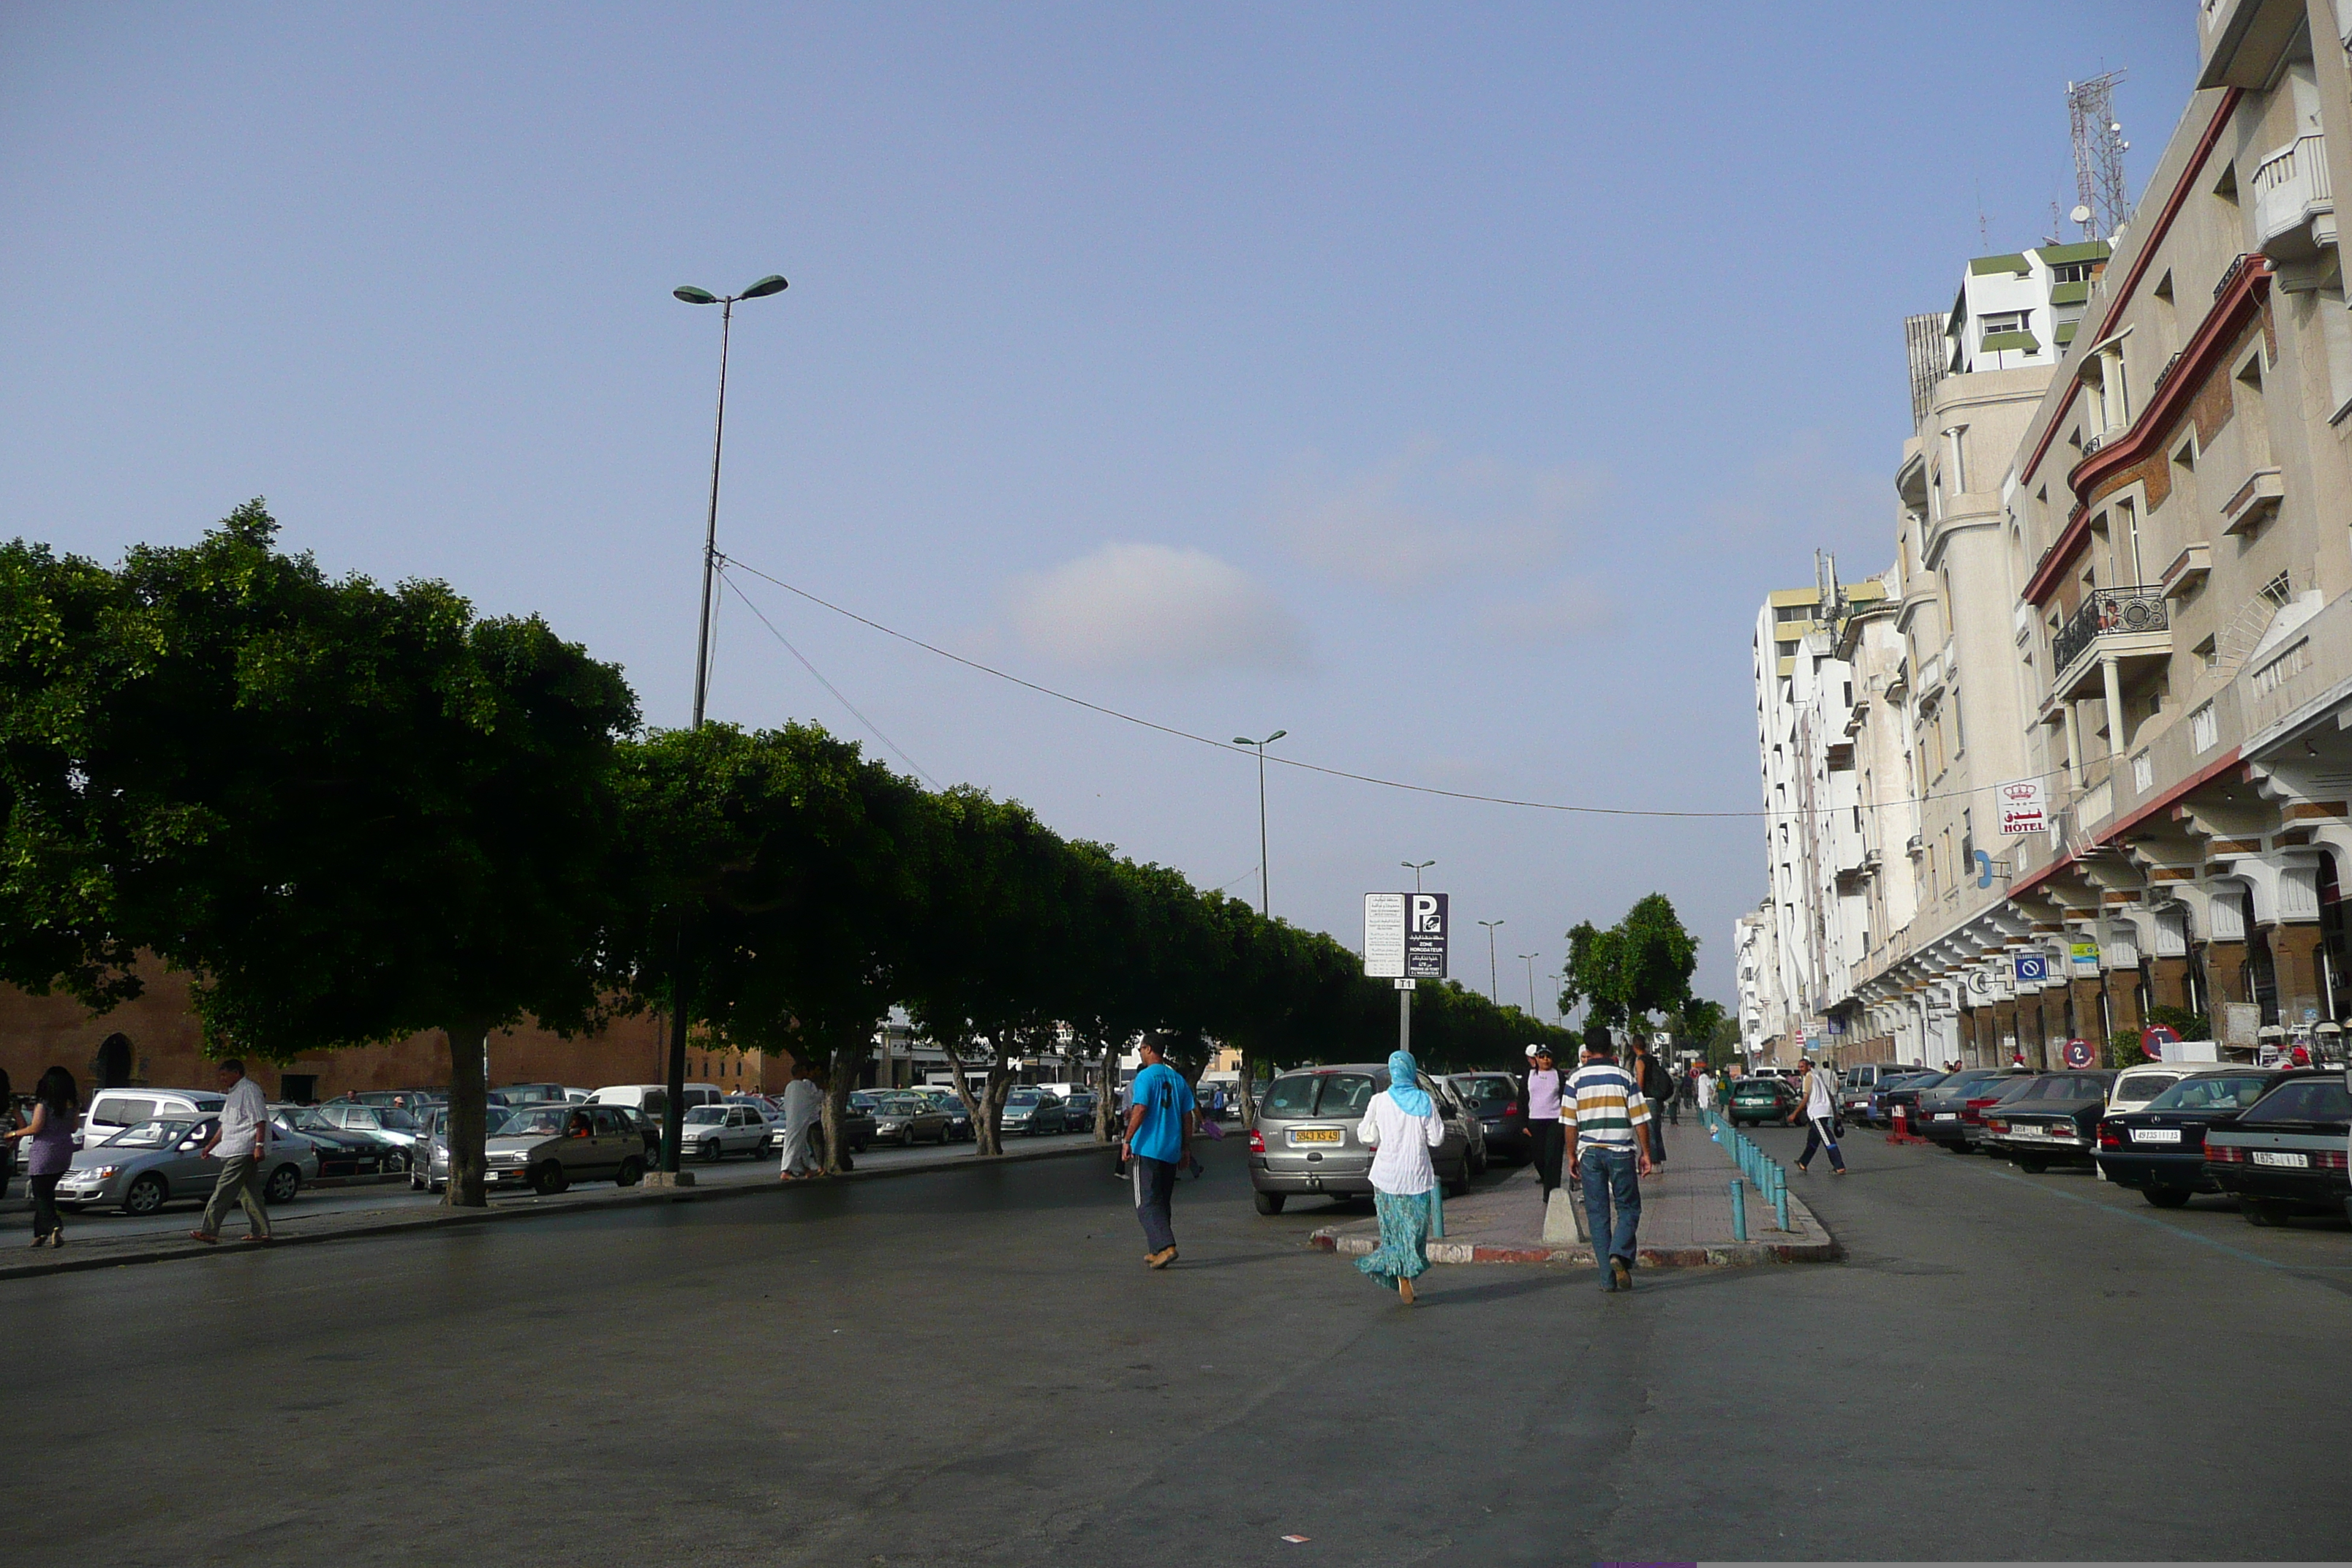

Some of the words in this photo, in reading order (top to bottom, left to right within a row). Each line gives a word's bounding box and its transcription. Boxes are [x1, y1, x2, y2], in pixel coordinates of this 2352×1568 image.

[2005, 808, 2043, 823] فندق
[1412, 894, 1438, 932] P
[1400, 980, 1411, 988] T1
[2074, 1047, 2084, 1060] 2
[1161, 1081, 1173, 1109] 3
[1329, 1131, 1338, 1140] 49
